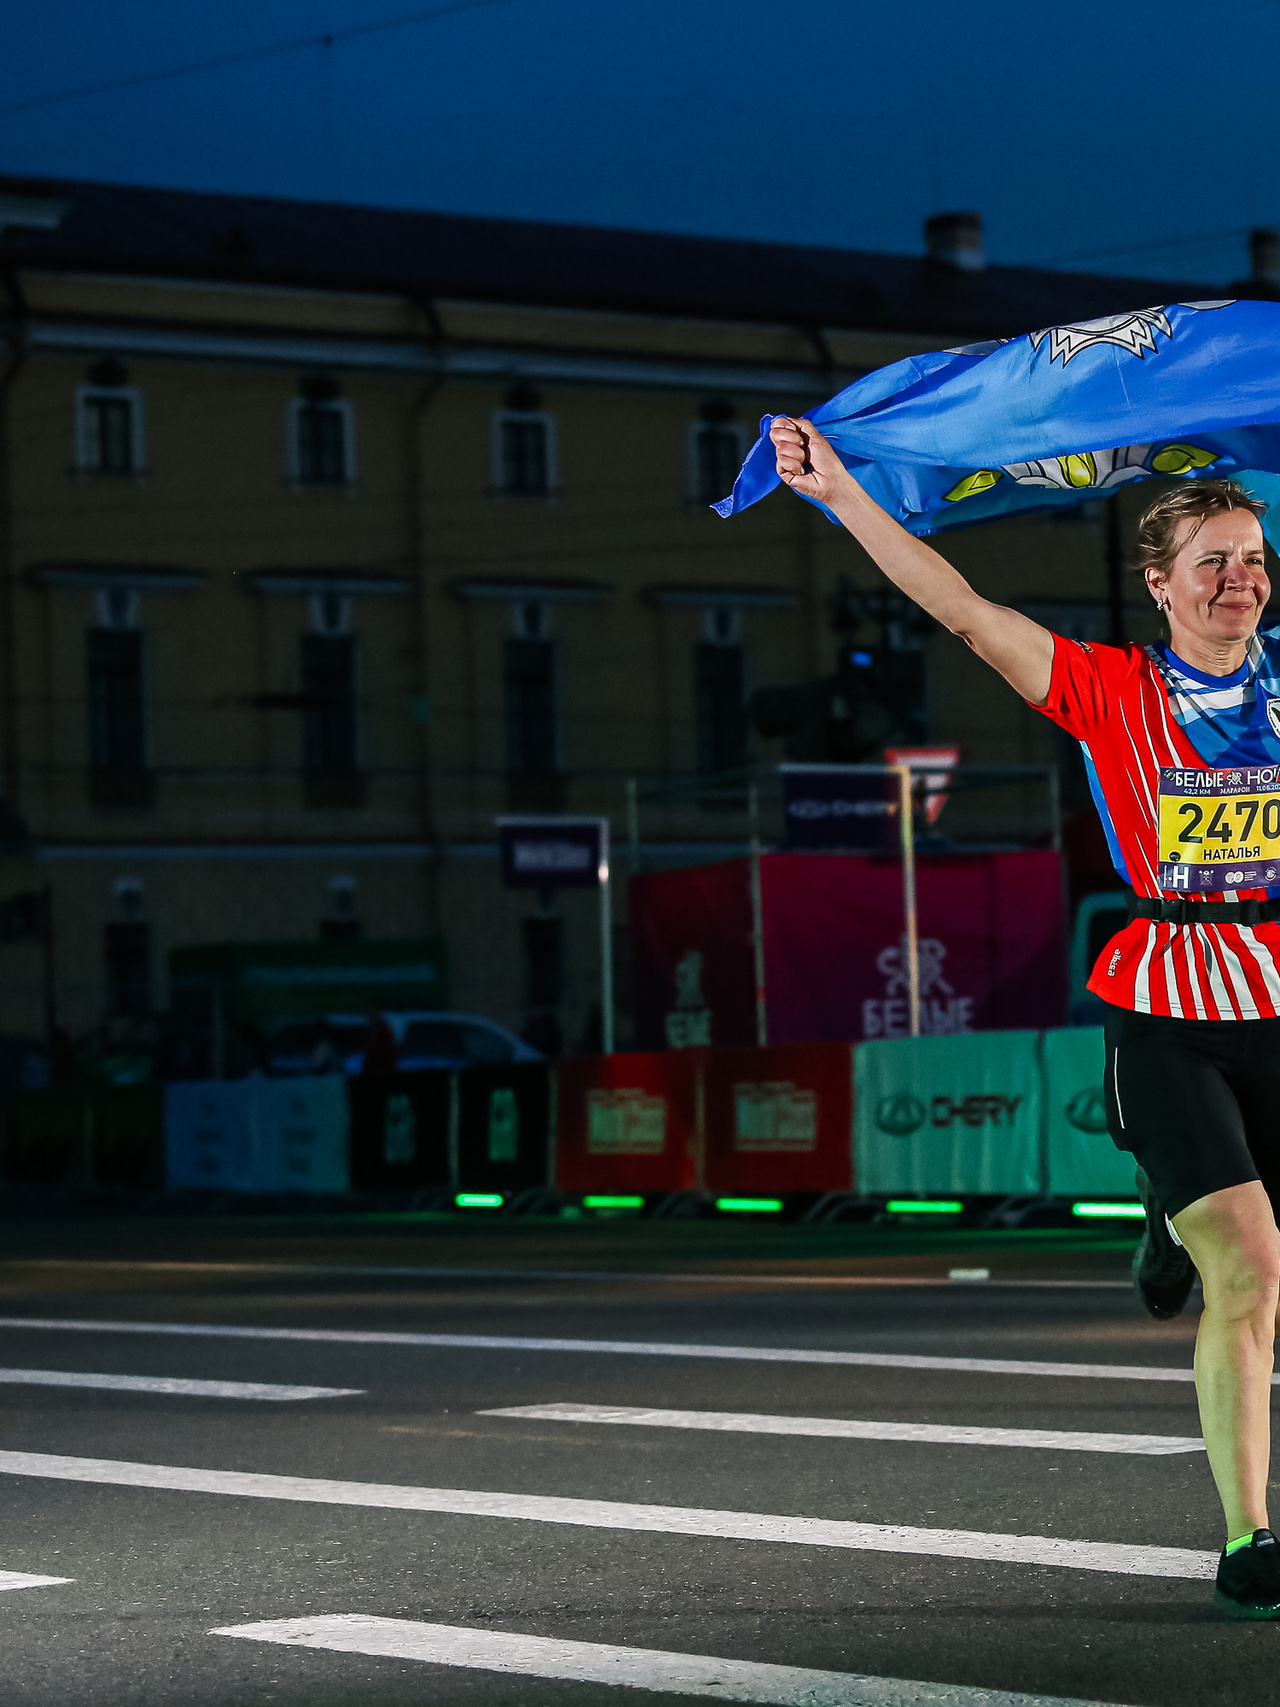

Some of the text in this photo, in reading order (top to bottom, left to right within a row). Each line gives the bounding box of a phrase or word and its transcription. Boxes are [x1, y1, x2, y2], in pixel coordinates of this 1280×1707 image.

[1175, 771, 1224, 788] БЕЛЫЕ
[1203, 846, 1261, 861] НАТАЛЬЯ
[932, 1094, 1022, 1128] CHERY
